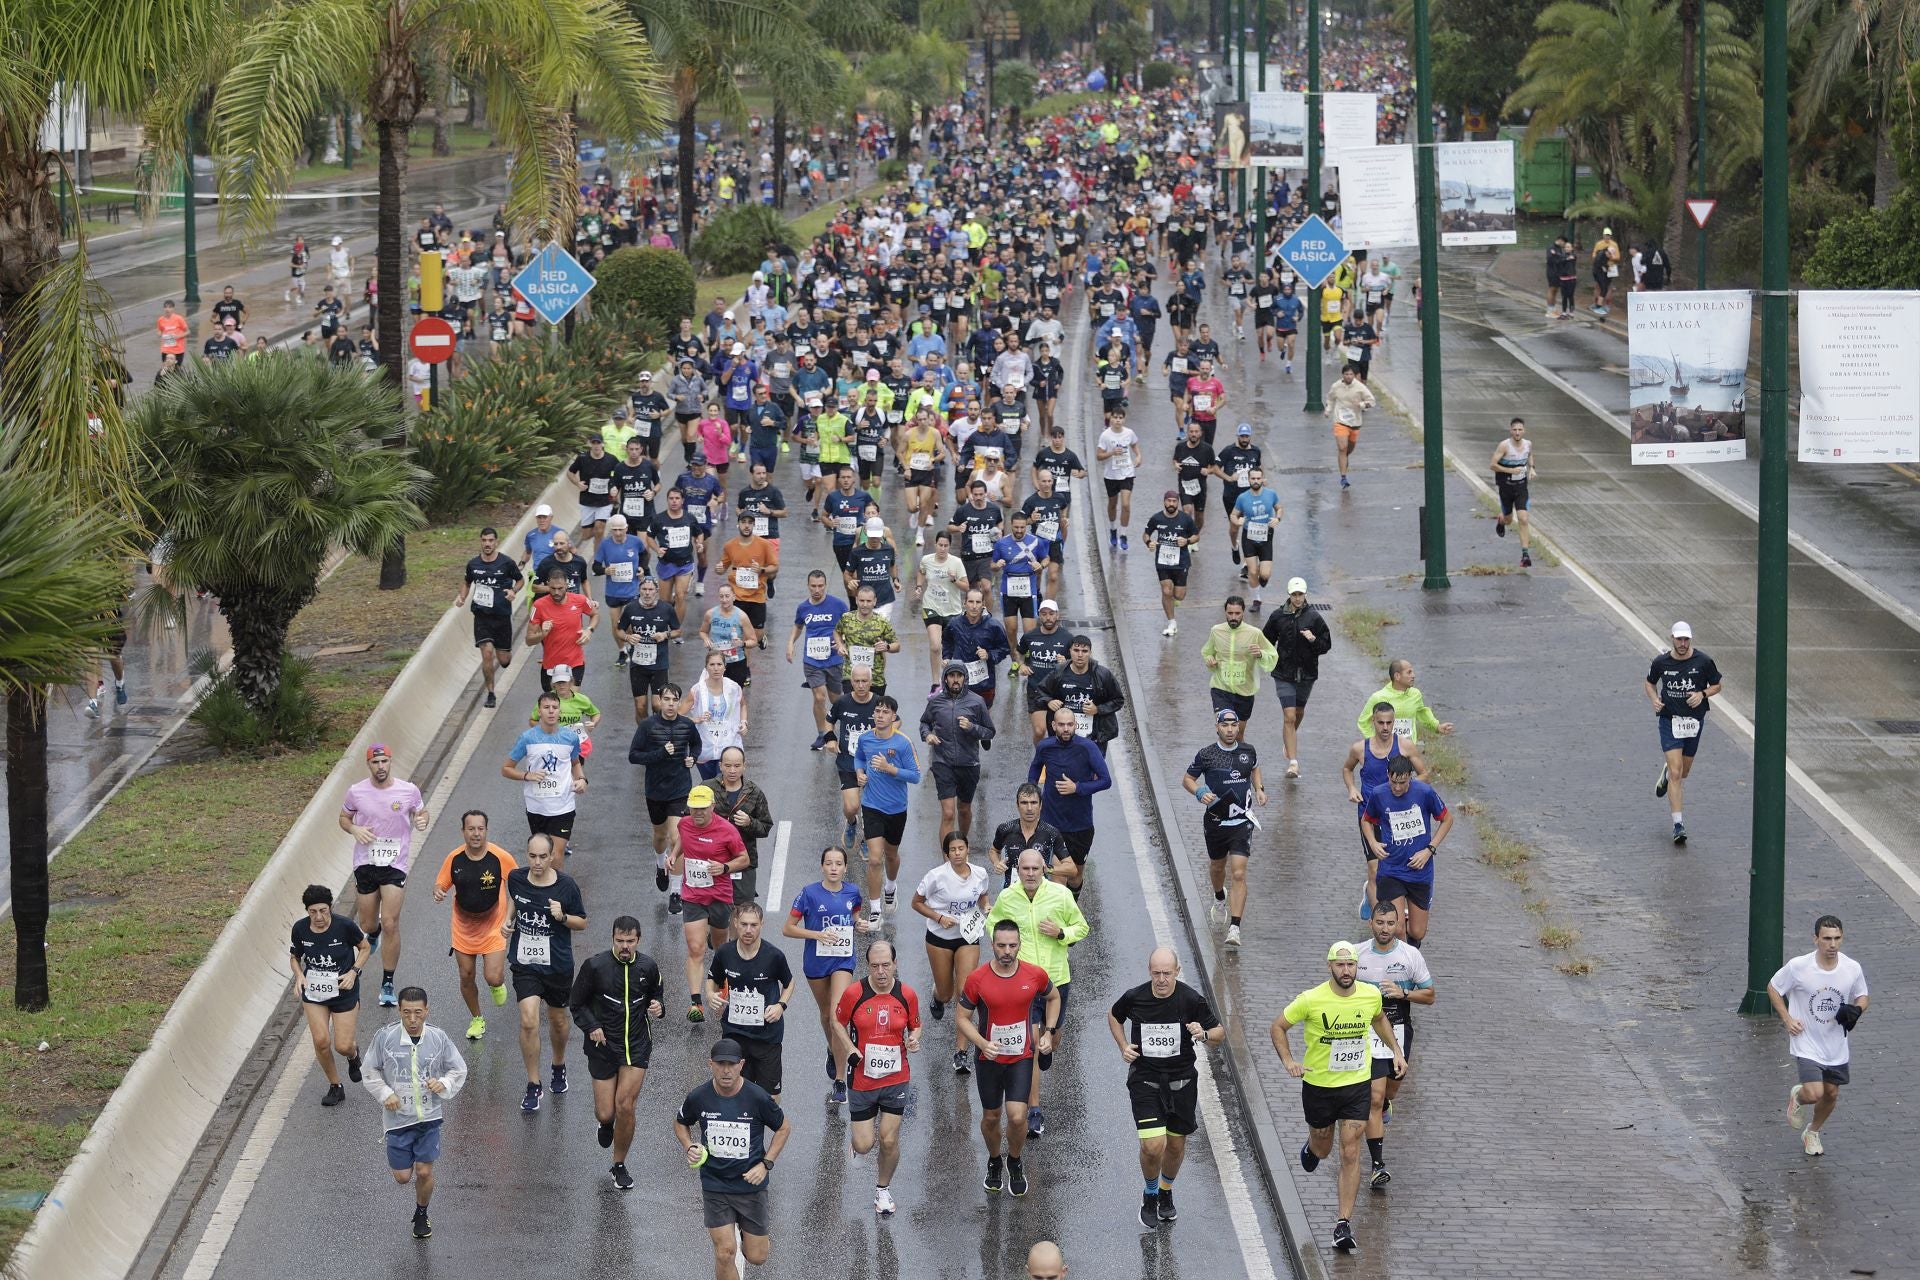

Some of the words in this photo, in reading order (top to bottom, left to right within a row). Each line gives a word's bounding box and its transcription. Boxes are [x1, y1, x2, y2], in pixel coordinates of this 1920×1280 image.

[1301, 240, 1326, 250] RED
[541, 271, 567, 281] RED
[1636, 303, 1645, 312] El
[1649, 302, 1744, 312] WESTMORLAND
[1636, 322, 1646, 330] en
[1650, 320, 1702, 329] MÁLAGA
[1806, 414, 1840, 422] 19.09.2024
[1880, 414, 1914, 422] 12.01.2025
[809, 645, 829, 654] 11059
[636, 651, 652, 659] 5191
[1678, 722, 1696, 730] 1186
[1394, 818, 1422, 831] 12639
[371, 849, 398, 857] 11795
[688, 870, 707, 879] 1458
[950, 900, 977, 910] RCM
[822, 914, 850, 928] RCM
[963, 910, 981, 935] 12946
[522, 946, 545, 956] 1283
[310, 984, 333, 993] 5459
[734, 1004, 759, 1014] 3735
[1334, 1022, 1366, 1030] QUEDADA
[997, 1035, 1023, 1046] 1338
[1148, 1037, 1175, 1047] 3589
[1334, 1050, 1365, 1062] 12957
[870, 1058, 896, 1069] 6967
[402, 1095, 428, 1105] 119
[711, 1135, 747, 1148] 13703
